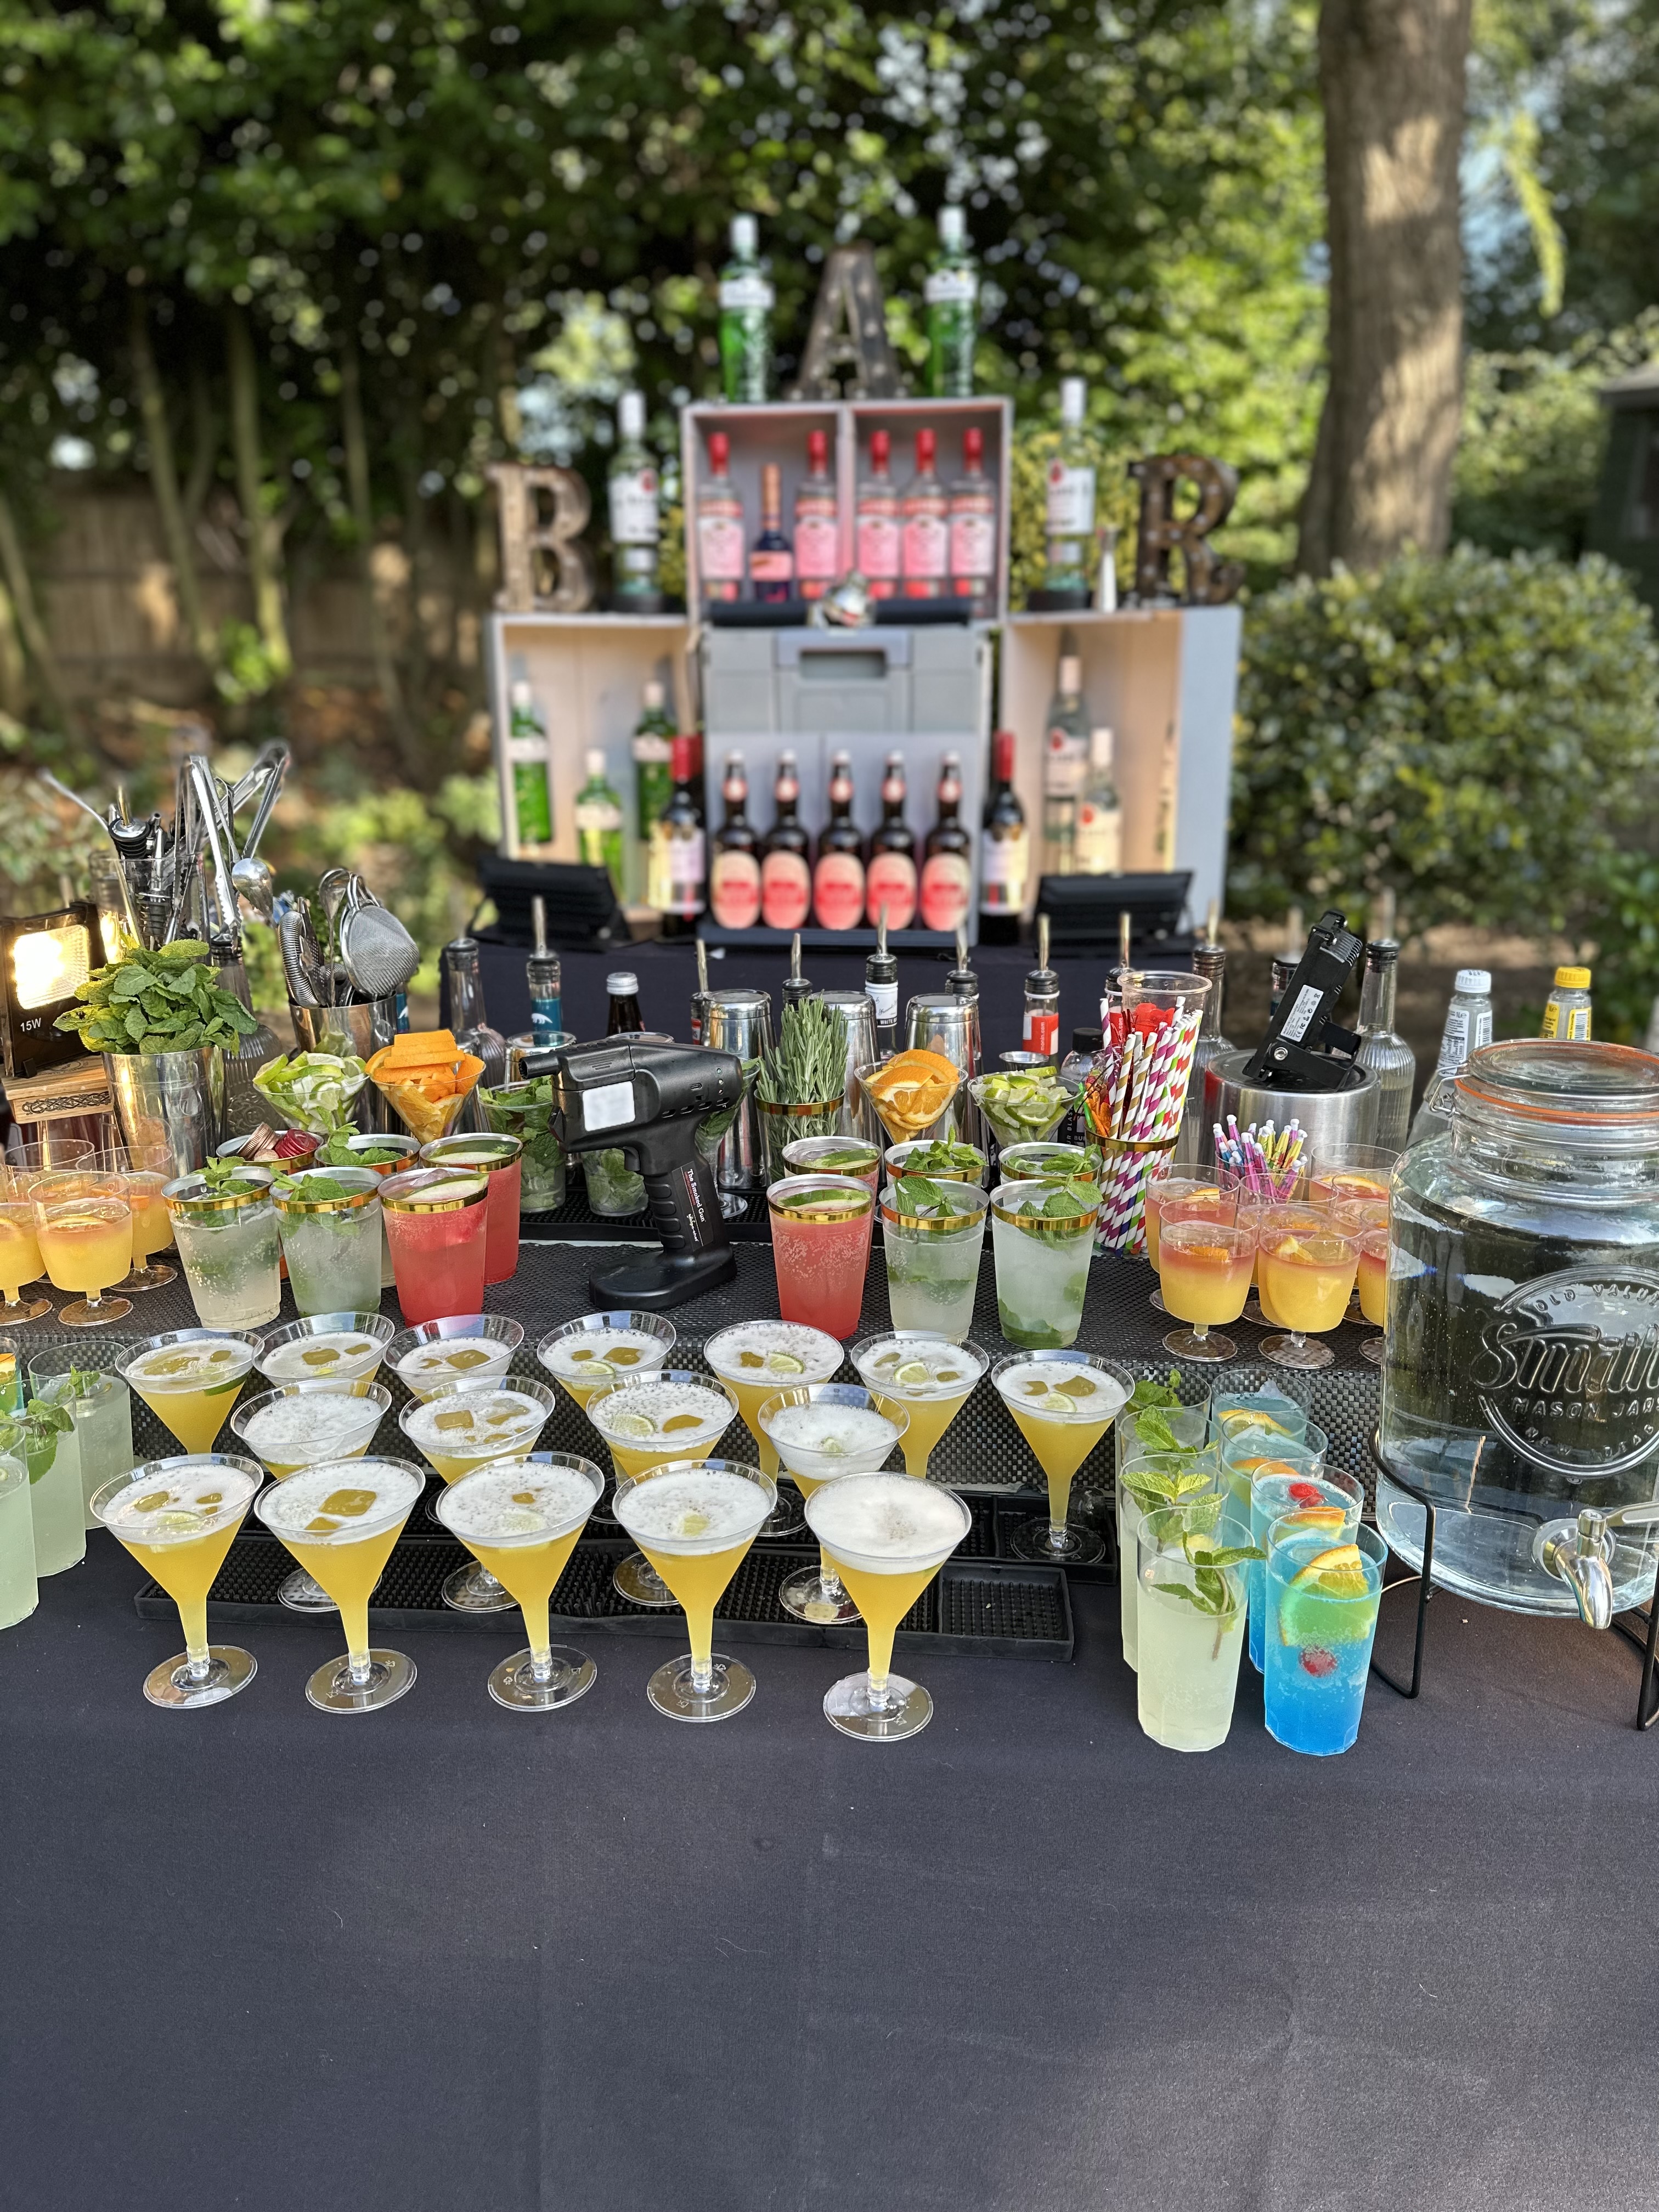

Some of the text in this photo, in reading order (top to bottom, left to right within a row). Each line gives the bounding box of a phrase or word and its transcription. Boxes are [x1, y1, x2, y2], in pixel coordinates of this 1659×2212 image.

[785, 241, 908, 399] A
[485, 464, 591, 612] B
[1128, 455, 1244, 605] R
[20, 1017, 42, 1032] 15W
[691, 1182, 702, 1208] Smoked
[1511, 1397, 1600, 1420] MASON
